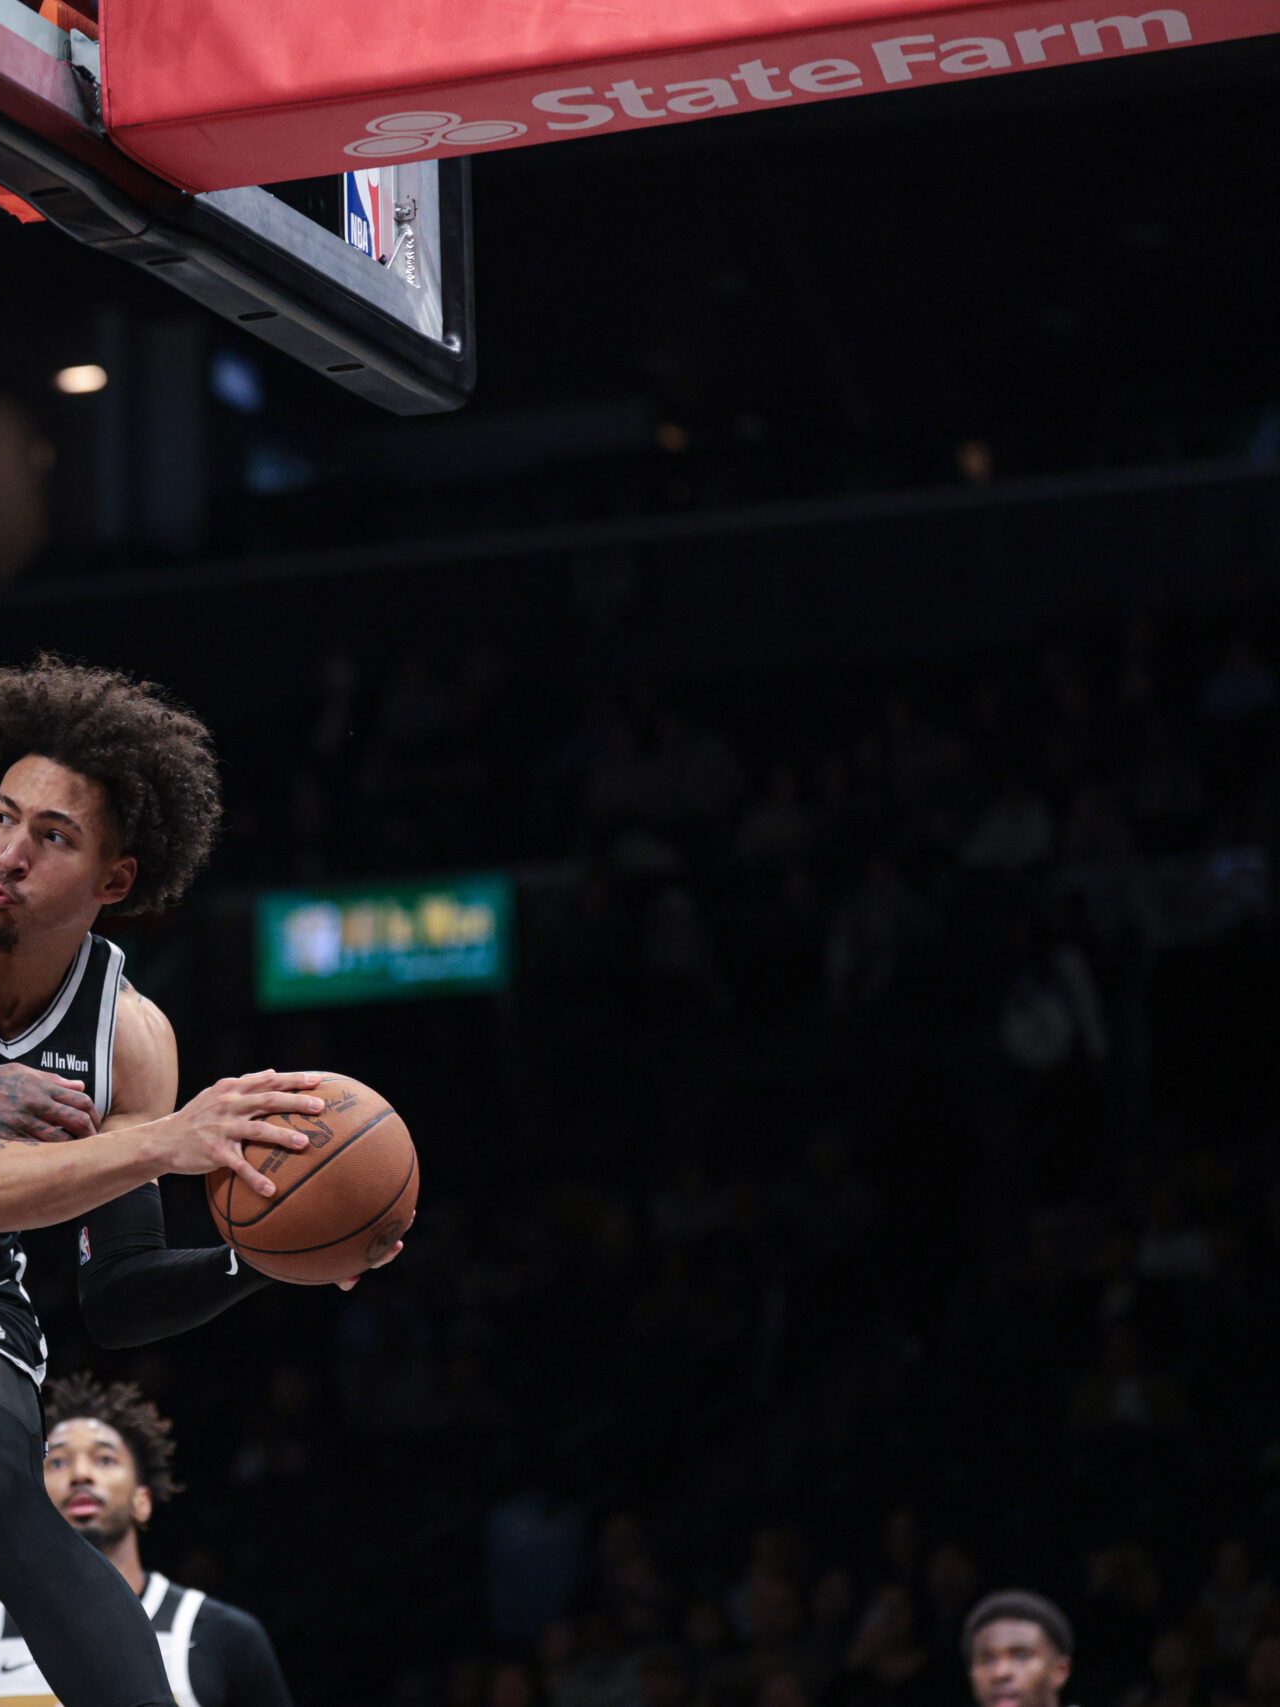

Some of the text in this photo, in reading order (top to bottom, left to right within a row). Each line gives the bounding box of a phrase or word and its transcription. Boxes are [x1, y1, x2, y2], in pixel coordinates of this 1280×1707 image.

[532, 8, 1193, 131] State Farm
[350, 212, 369, 253] NBA
[41, 1051, 89, 1072] All In Won
